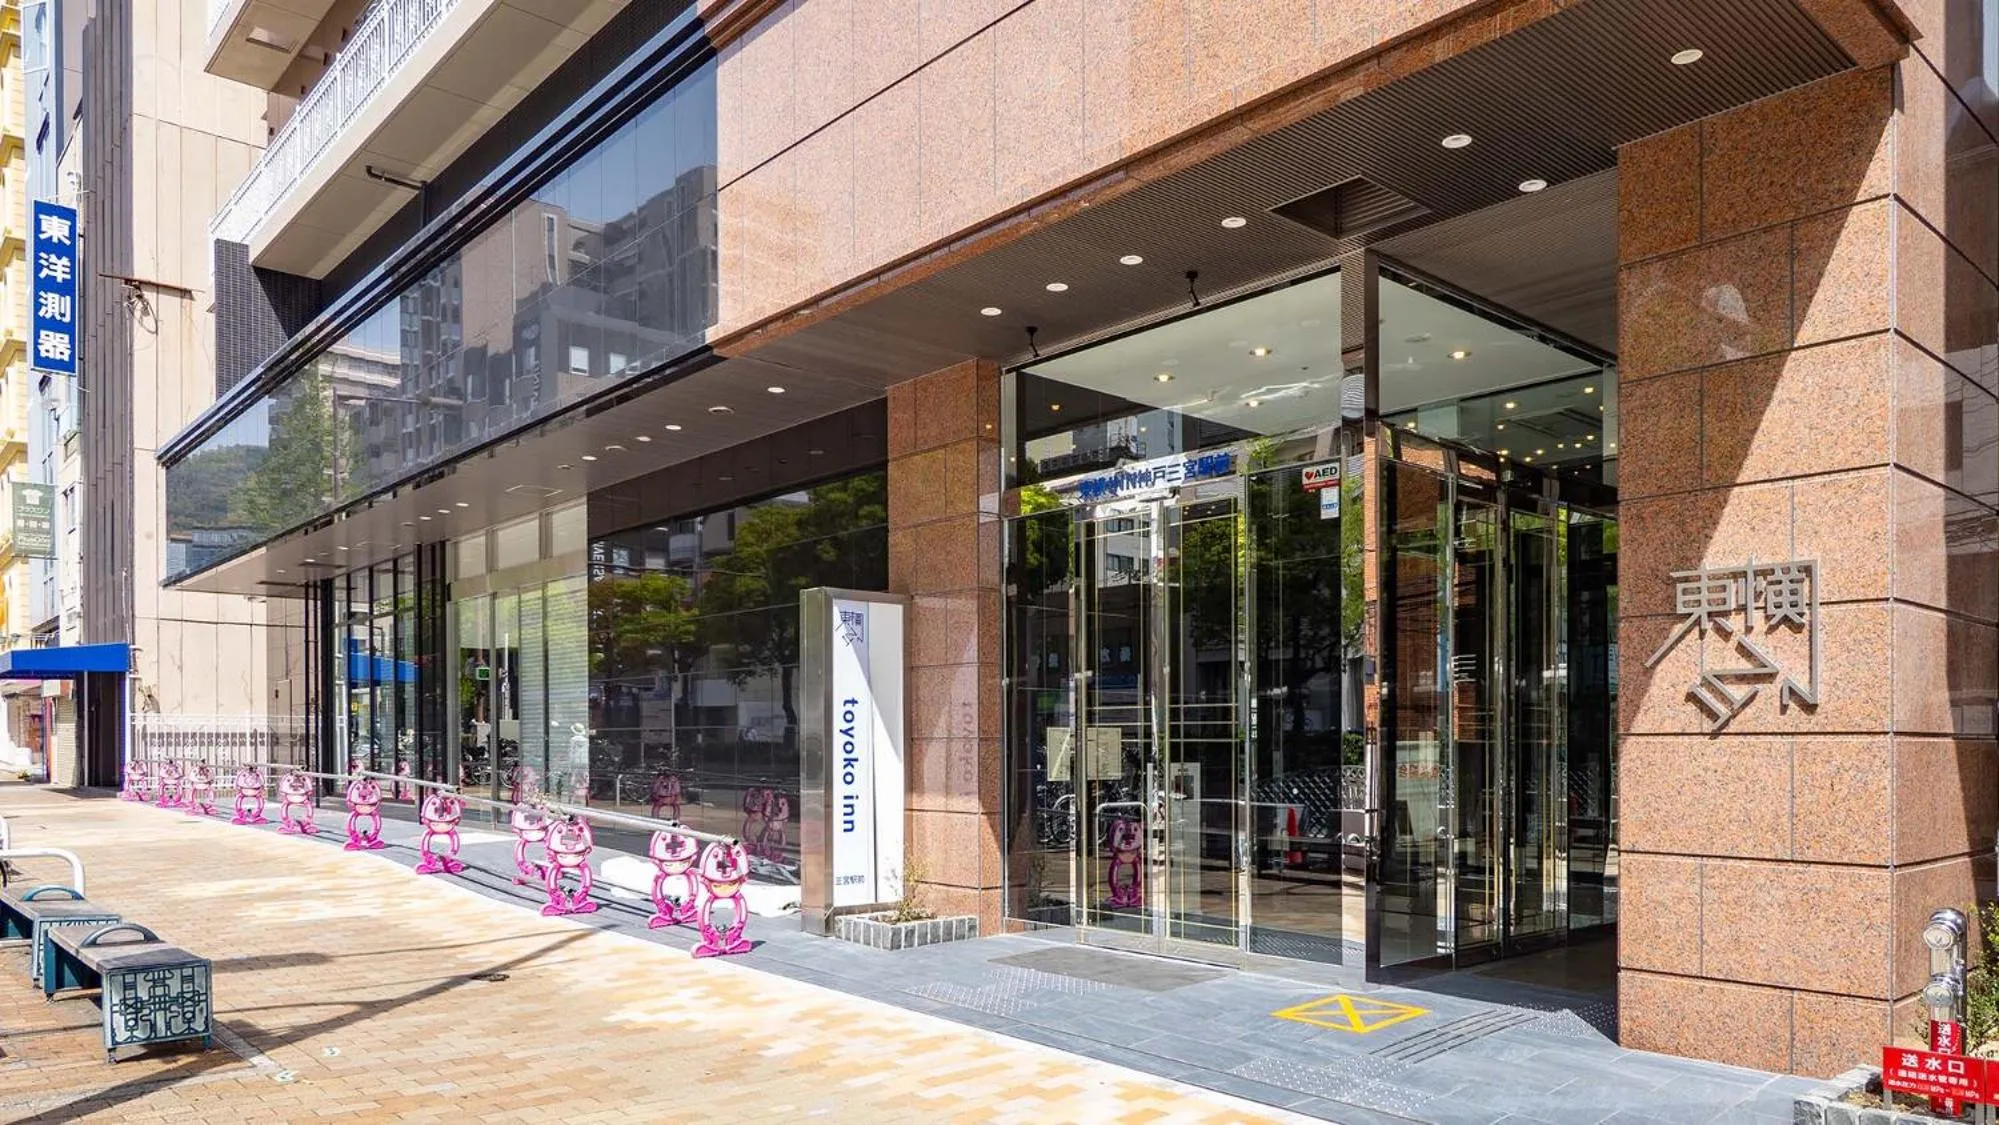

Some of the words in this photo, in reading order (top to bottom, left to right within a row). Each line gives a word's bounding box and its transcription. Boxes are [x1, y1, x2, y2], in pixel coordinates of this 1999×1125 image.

[38, 214, 72, 362] 東洋測器
[1314, 466, 1338, 479] AED
[839, 697, 859, 785] toyoko
[843, 795, 859, 832] inn
[1901, 1052, 1965, 1075] 送水口
